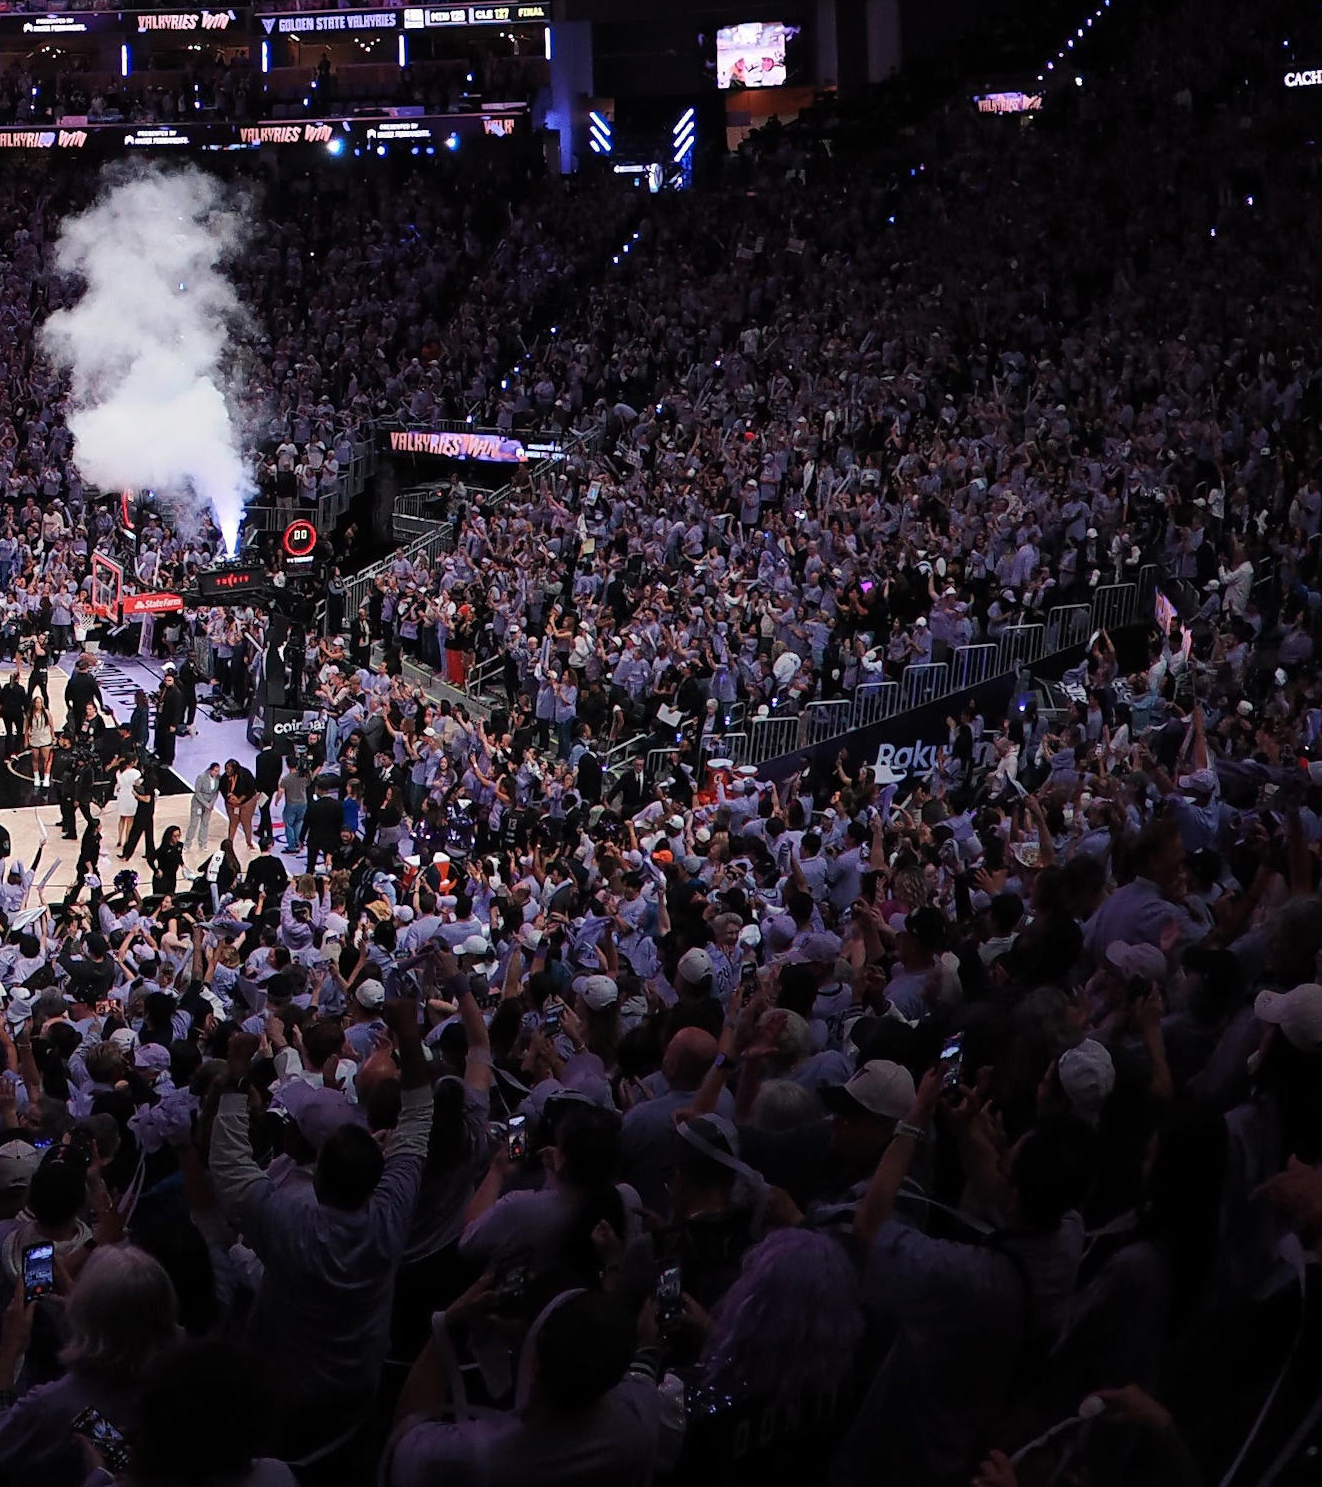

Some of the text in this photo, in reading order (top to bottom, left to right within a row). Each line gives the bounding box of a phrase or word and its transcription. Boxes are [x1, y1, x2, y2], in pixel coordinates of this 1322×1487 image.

[518, 6, 544, 18] FINAL
[137, 14, 198, 31] VALKYRIES
[279, 12, 396, 32] GOLDEN STATE VALKYRIES
[59, 130, 87, 147] WIN
[240, 126, 299, 143] VALKYRIES
[390, 432, 461, 456] VALKYRIES
